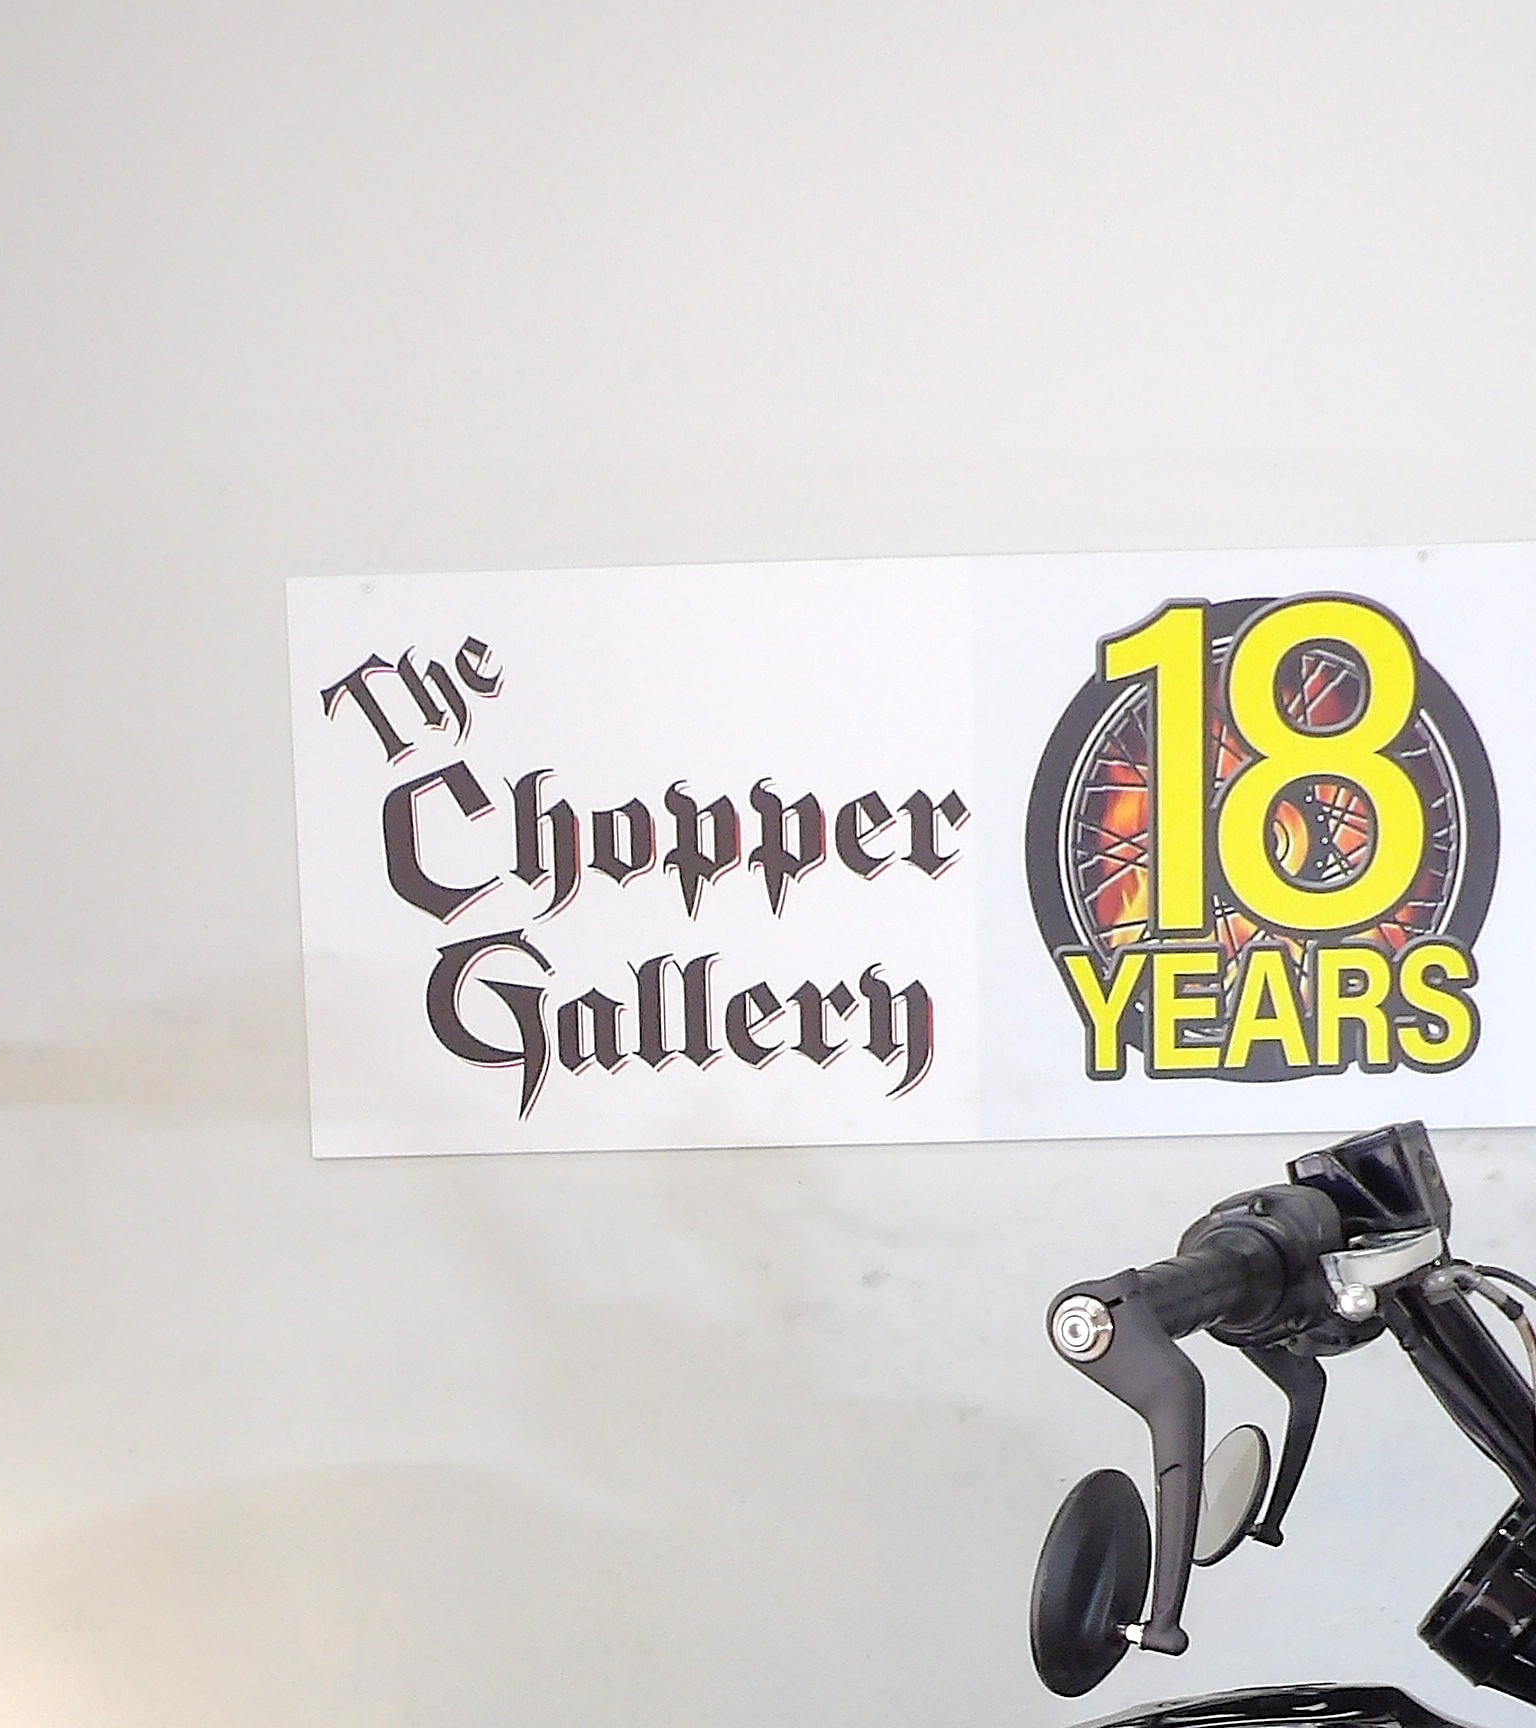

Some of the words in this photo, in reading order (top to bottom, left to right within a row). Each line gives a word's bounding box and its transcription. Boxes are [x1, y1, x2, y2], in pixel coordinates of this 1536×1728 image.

[321, 634, 505, 765] The
[1098, 593, 1430, 940] 18
[381, 759, 972, 924] Chopper
[424, 930, 936, 1121] Gallery
[1059, 942, 1479, 1080] YEARS
